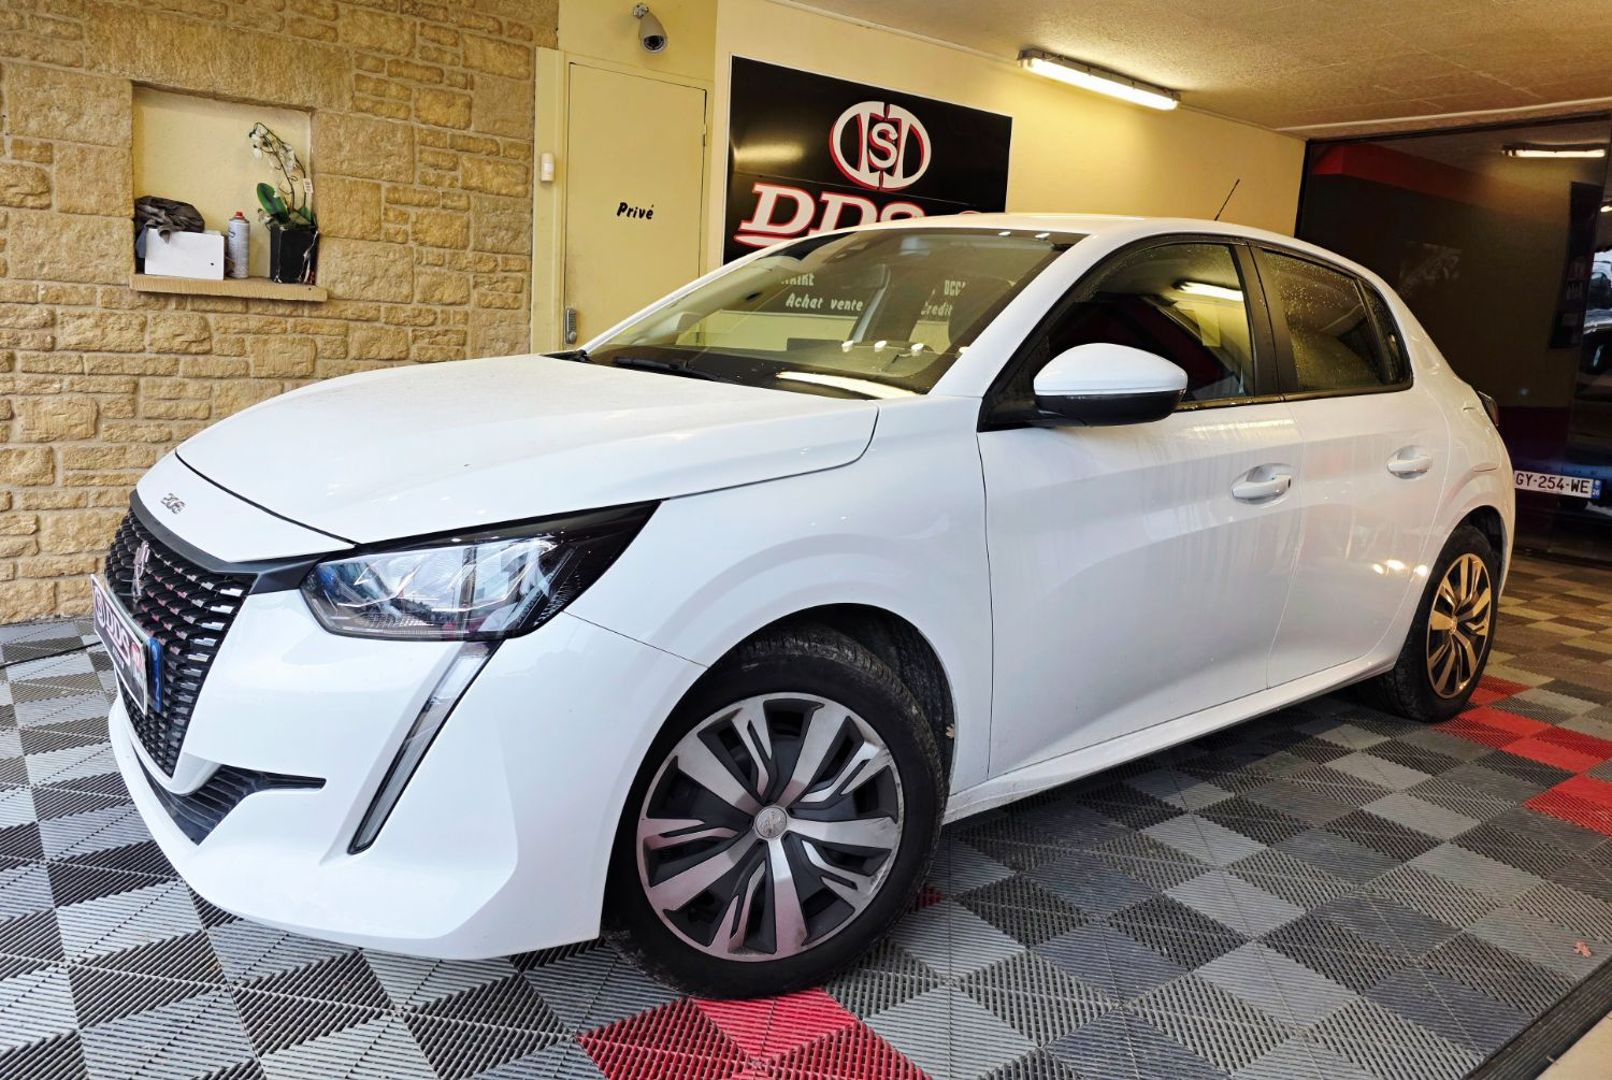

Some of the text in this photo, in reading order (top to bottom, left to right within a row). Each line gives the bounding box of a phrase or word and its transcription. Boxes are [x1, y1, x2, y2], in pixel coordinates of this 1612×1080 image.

[616, 201, 655, 220] Privé
[785, 293, 863, 311] Achat vente
[1515, 472, 1590, 494] GY-254-WE
